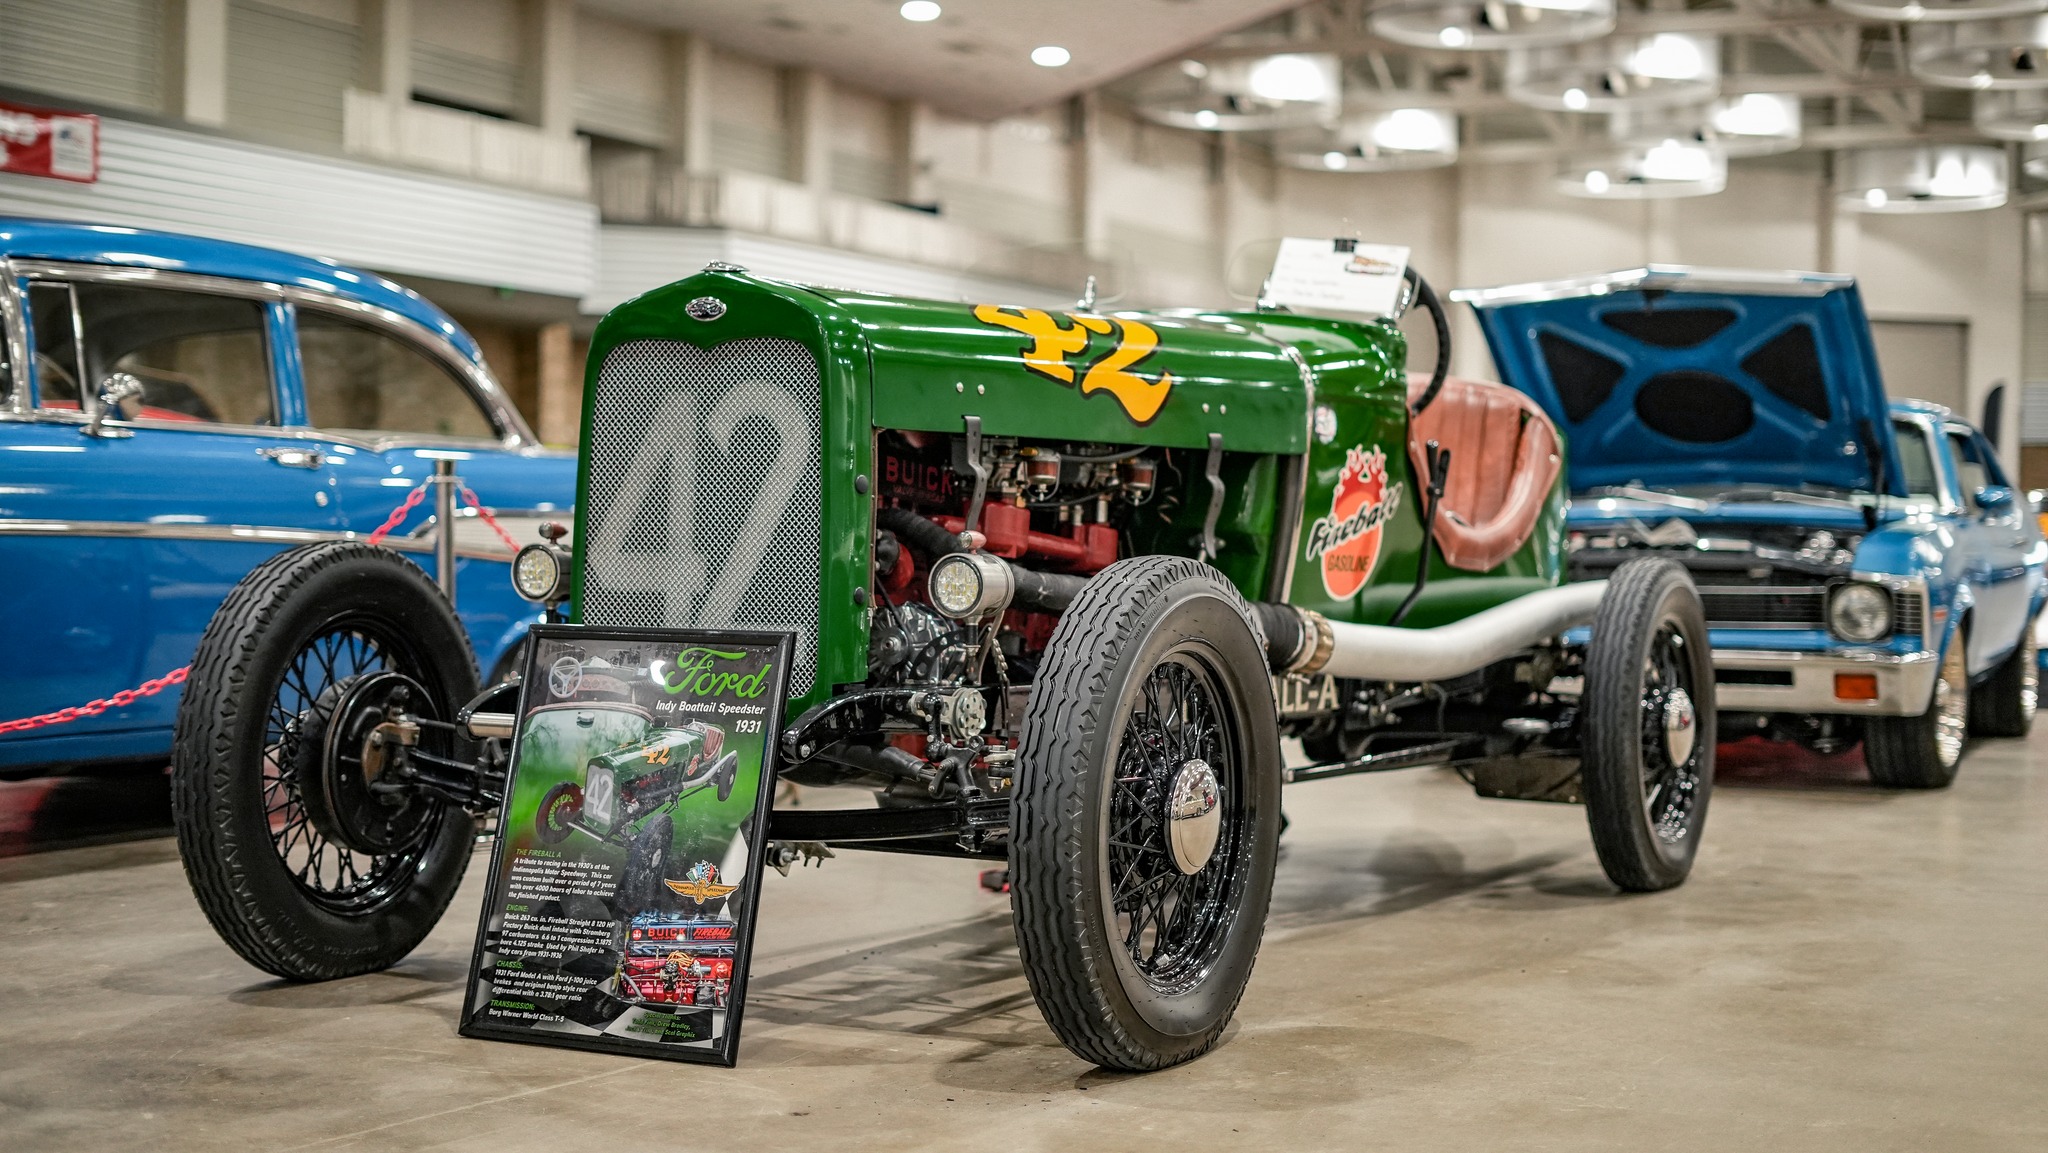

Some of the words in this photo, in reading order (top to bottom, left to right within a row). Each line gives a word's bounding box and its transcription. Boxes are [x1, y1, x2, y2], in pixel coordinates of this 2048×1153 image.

[969, 304, 1174, 427] 42
[886, 455, 952, 496] BUICK
[587, 378, 810, 626] 42
[1306, 481, 1403, 561] Fireball
[1328, 554, 1370, 572] GASOLINE
[664, 647, 772, 698] Ford
[656, 700, 676, 712] Indy
[679, 701, 716, 712] Boattail
[718, 703, 765, 715] Speedster
[735, 720, 762, 733] 1931
[586, 774, 613, 825] 42
[528, 849, 555, 857] FIREBALL
[513, 866, 544, 874] Indianapolis
[561, 870, 587, 878] Speedway.
[535, 884, 549, 892] 4000
[565, 887, 572, 895] of
[506, 904, 529, 912] ENGINE:
[548, 916, 568, 924] Fireball
[569, 918, 591, 927] Straight
[503, 922, 523, 930] Factory
[583, 928, 611, 938] Stromberg
[648, 928, 686, 938] BUICK
[693, 928, 732, 936] FIREBALL
[561, 936, 594, 944] compression
[595, 938, 612, 946] 3.1875
[499, 947, 510, 955] Indy
[560, 944, 567, 952] by
[580, 946, 598, 954] Shafer
[496, 960, 524, 969] CHASSIS:
[568, 976, 583, 984] f-100
[583, 977, 597, 985] juice
[492, 986, 522, 996] differential
[525, 981, 546, 989] original
[546, 983, 562, 991] banjo
[562, 984, 576, 992] style
[490, 1000, 536, 1010] TRANSMISSION:
[489, 1008, 502, 1017] Borg
[502, 1010, 522, 1018] Warner
[522, 1011, 539, 1019] World
[539, 1013, 554, 1021] Class
[671, 1022, 691, 1030] Bradley,
